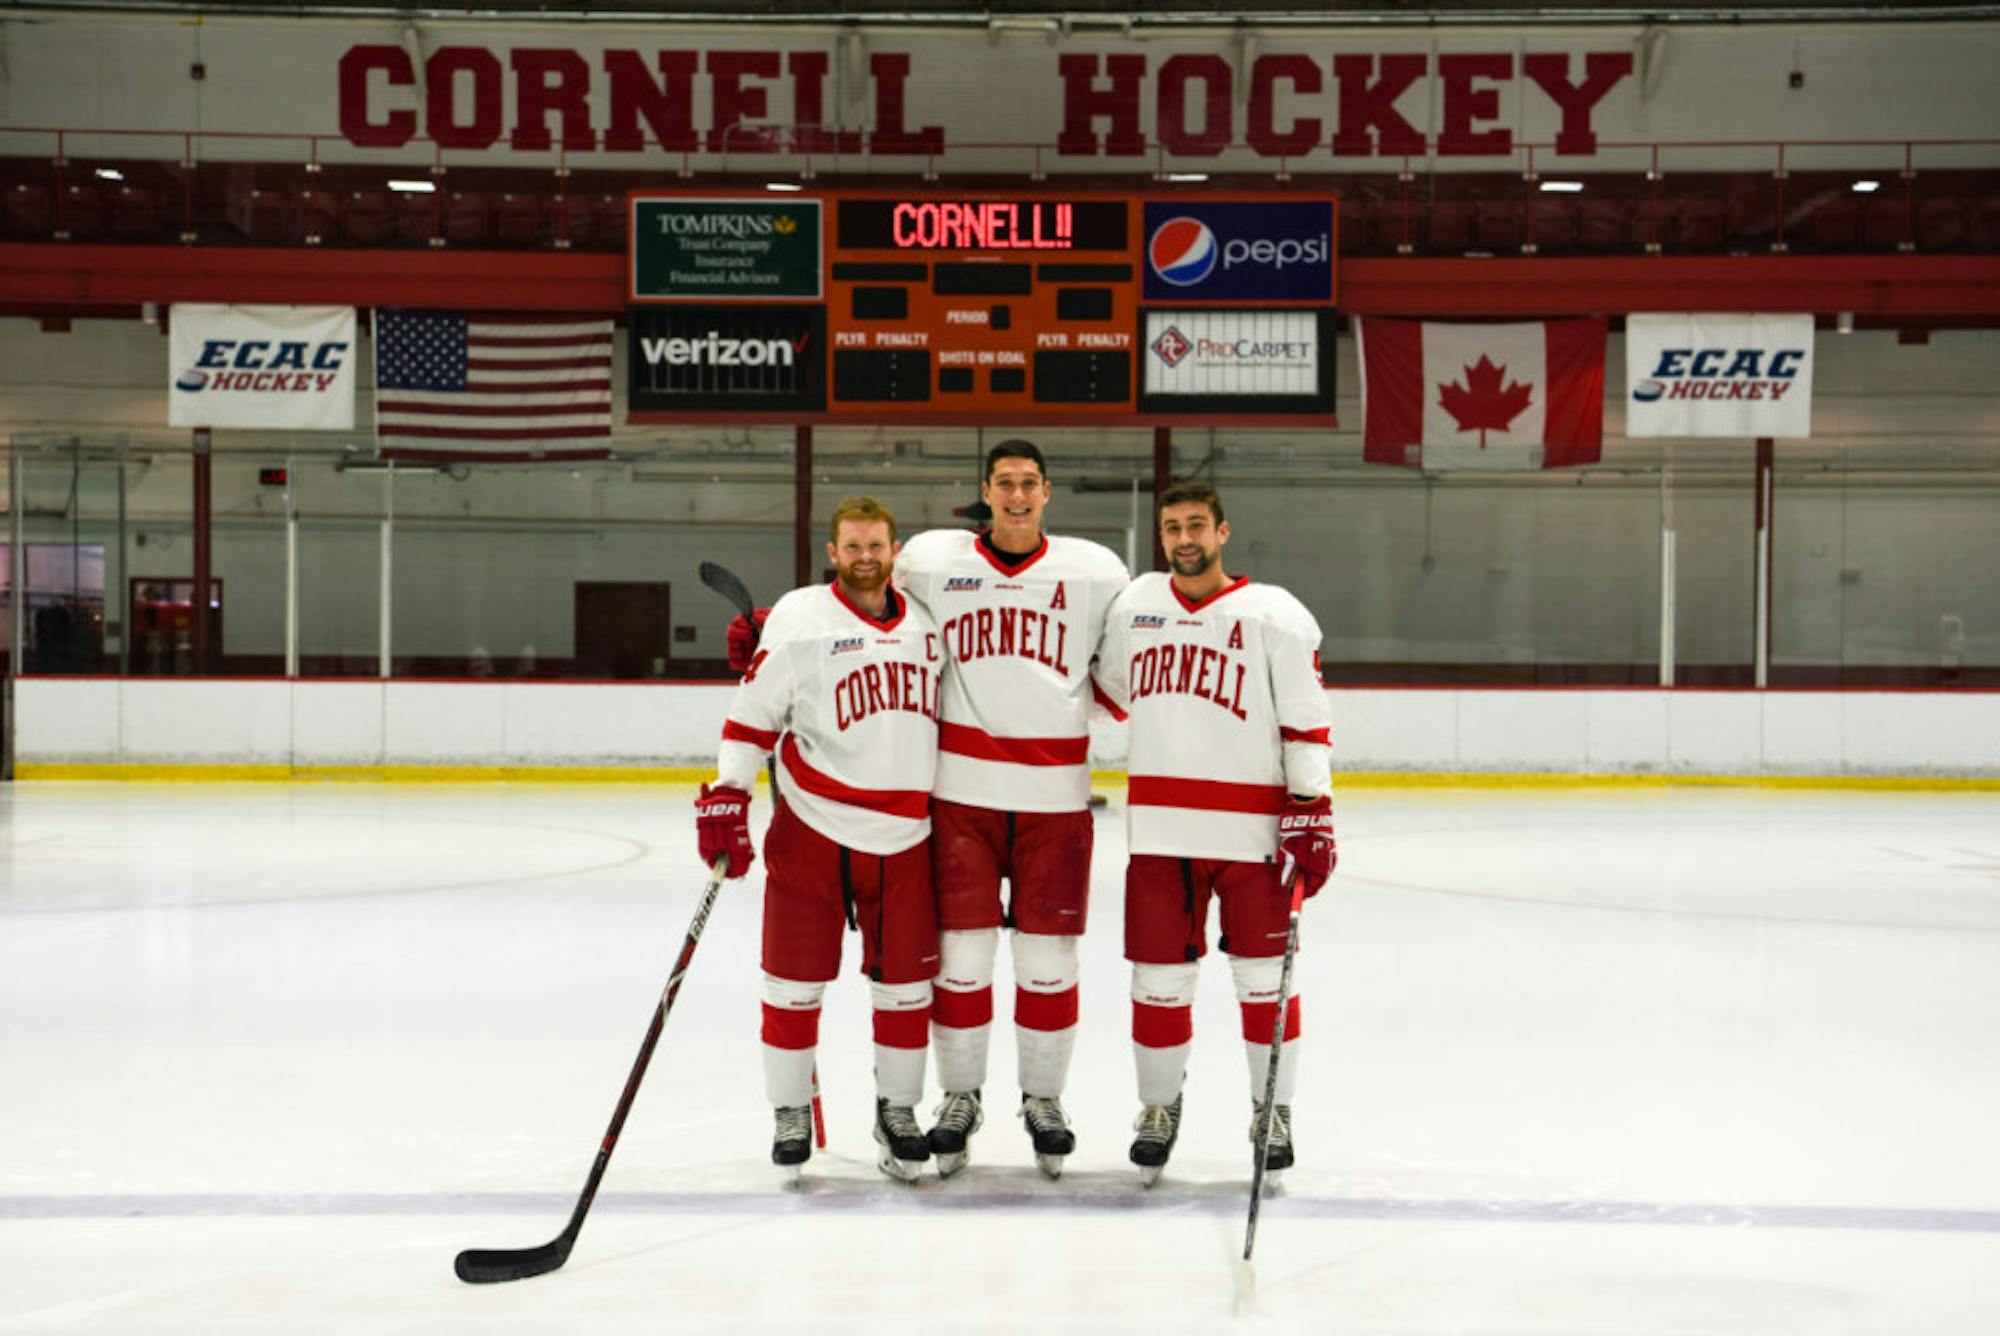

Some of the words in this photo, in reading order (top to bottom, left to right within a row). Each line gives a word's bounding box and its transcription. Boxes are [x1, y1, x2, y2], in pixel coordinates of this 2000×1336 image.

[338, 44, 945, 155] CORNELL
[1058, 52, 1634, 156] HOCKEY
[656, 214, 773, 238] TOMPKINS
[678, 237, 710, 251] Trust
[712, 239, 769, 255] Company
[1223, 233, 1328, 269] pepsi
[695, 254, 754, 267] Insurance
[670, 270, 725, 284] Financial
[946, 310, 989, 324] PERIOD
[640, 331, 793, 366] verizon
[836, 332, 866, 346] PLYR
[876, 332, 928, 346] PENALTY
[1037, 333, 1067, 347] PLYR
[1078, 333, 1130, 347] PENALTY
[195, 340, 349, 370] ECAC
[939, 352, 975, 365] SHOTS
[978, 352, 994, 365] ON
[997, 352, 1027, 365] GOAL
[1652, 349, 1805, 378] ECAC
[210, 371, 336, 392] HOCKEY
[1668, 380, 1792, 401] HOCKEY
[1050, 580, 1067, 611] A
[925, 632, 939, 661] C
[944, 606, 1069, 678] CORNELL
[1227, 619, 1244, 650] A
[1130, 643, 1247, 721] CORNELL
